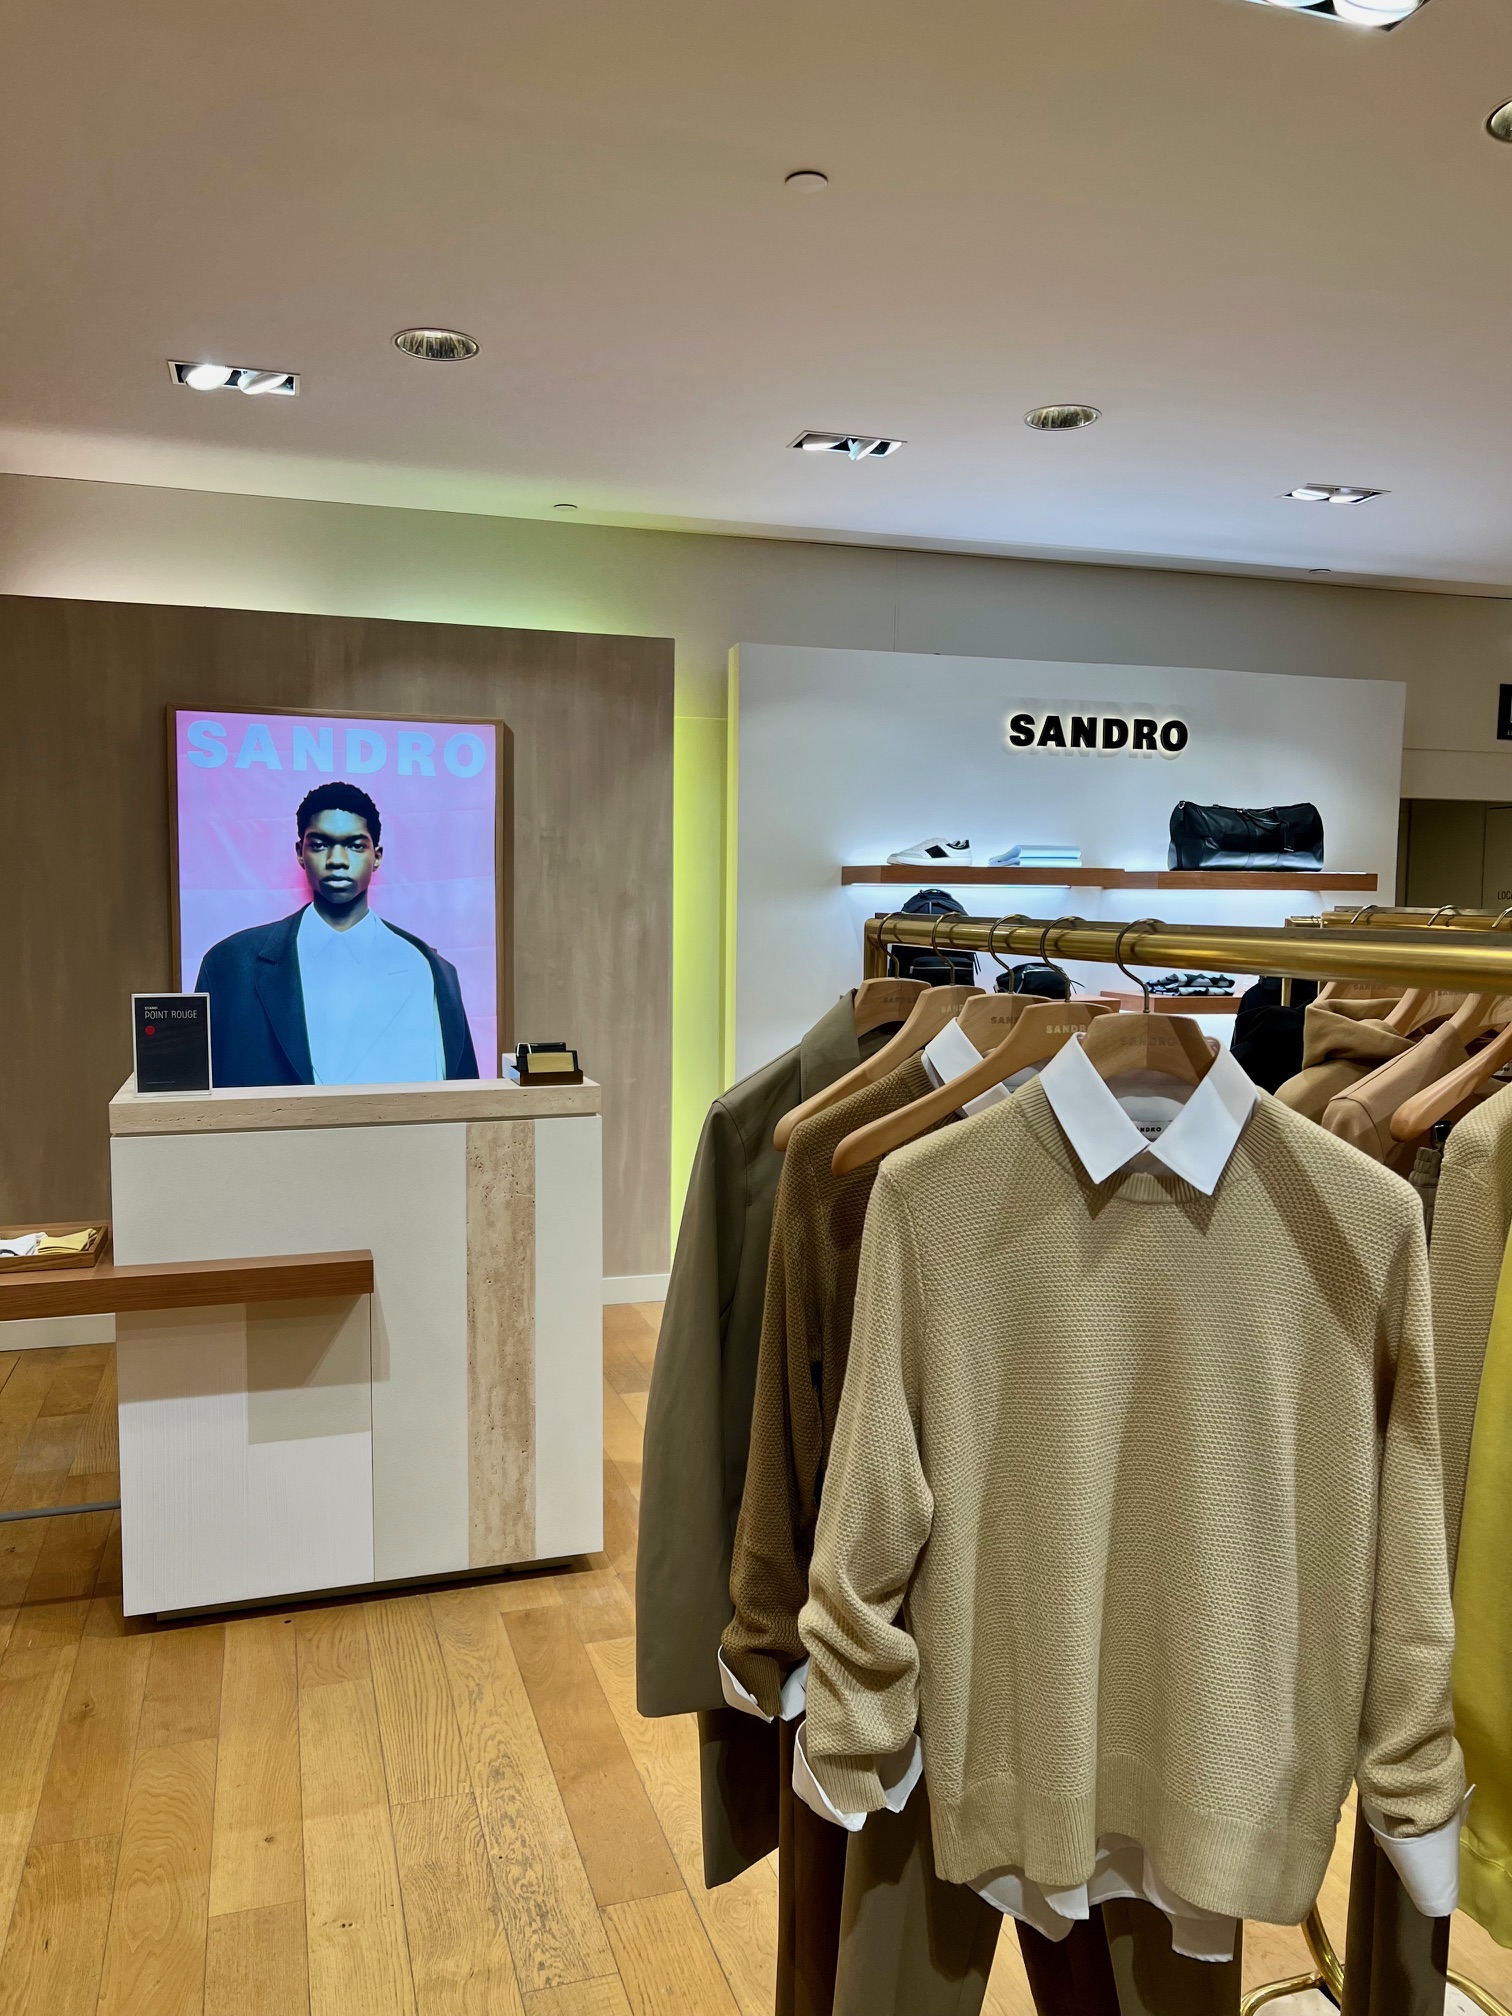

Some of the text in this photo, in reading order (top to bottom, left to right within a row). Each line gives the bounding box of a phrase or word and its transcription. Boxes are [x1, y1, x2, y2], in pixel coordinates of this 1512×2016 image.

[1009, 713, 1189, 752] SANDRO
[187, 720, 486, 778] SANDRO
[941, 1004, 963, 1013] SAND
[144, 1009, 198, 1020] POINT ROUGE
[990, 1016, 1019, 1024] SAN
[1046, 1024, 1088, 1034] SANDR
